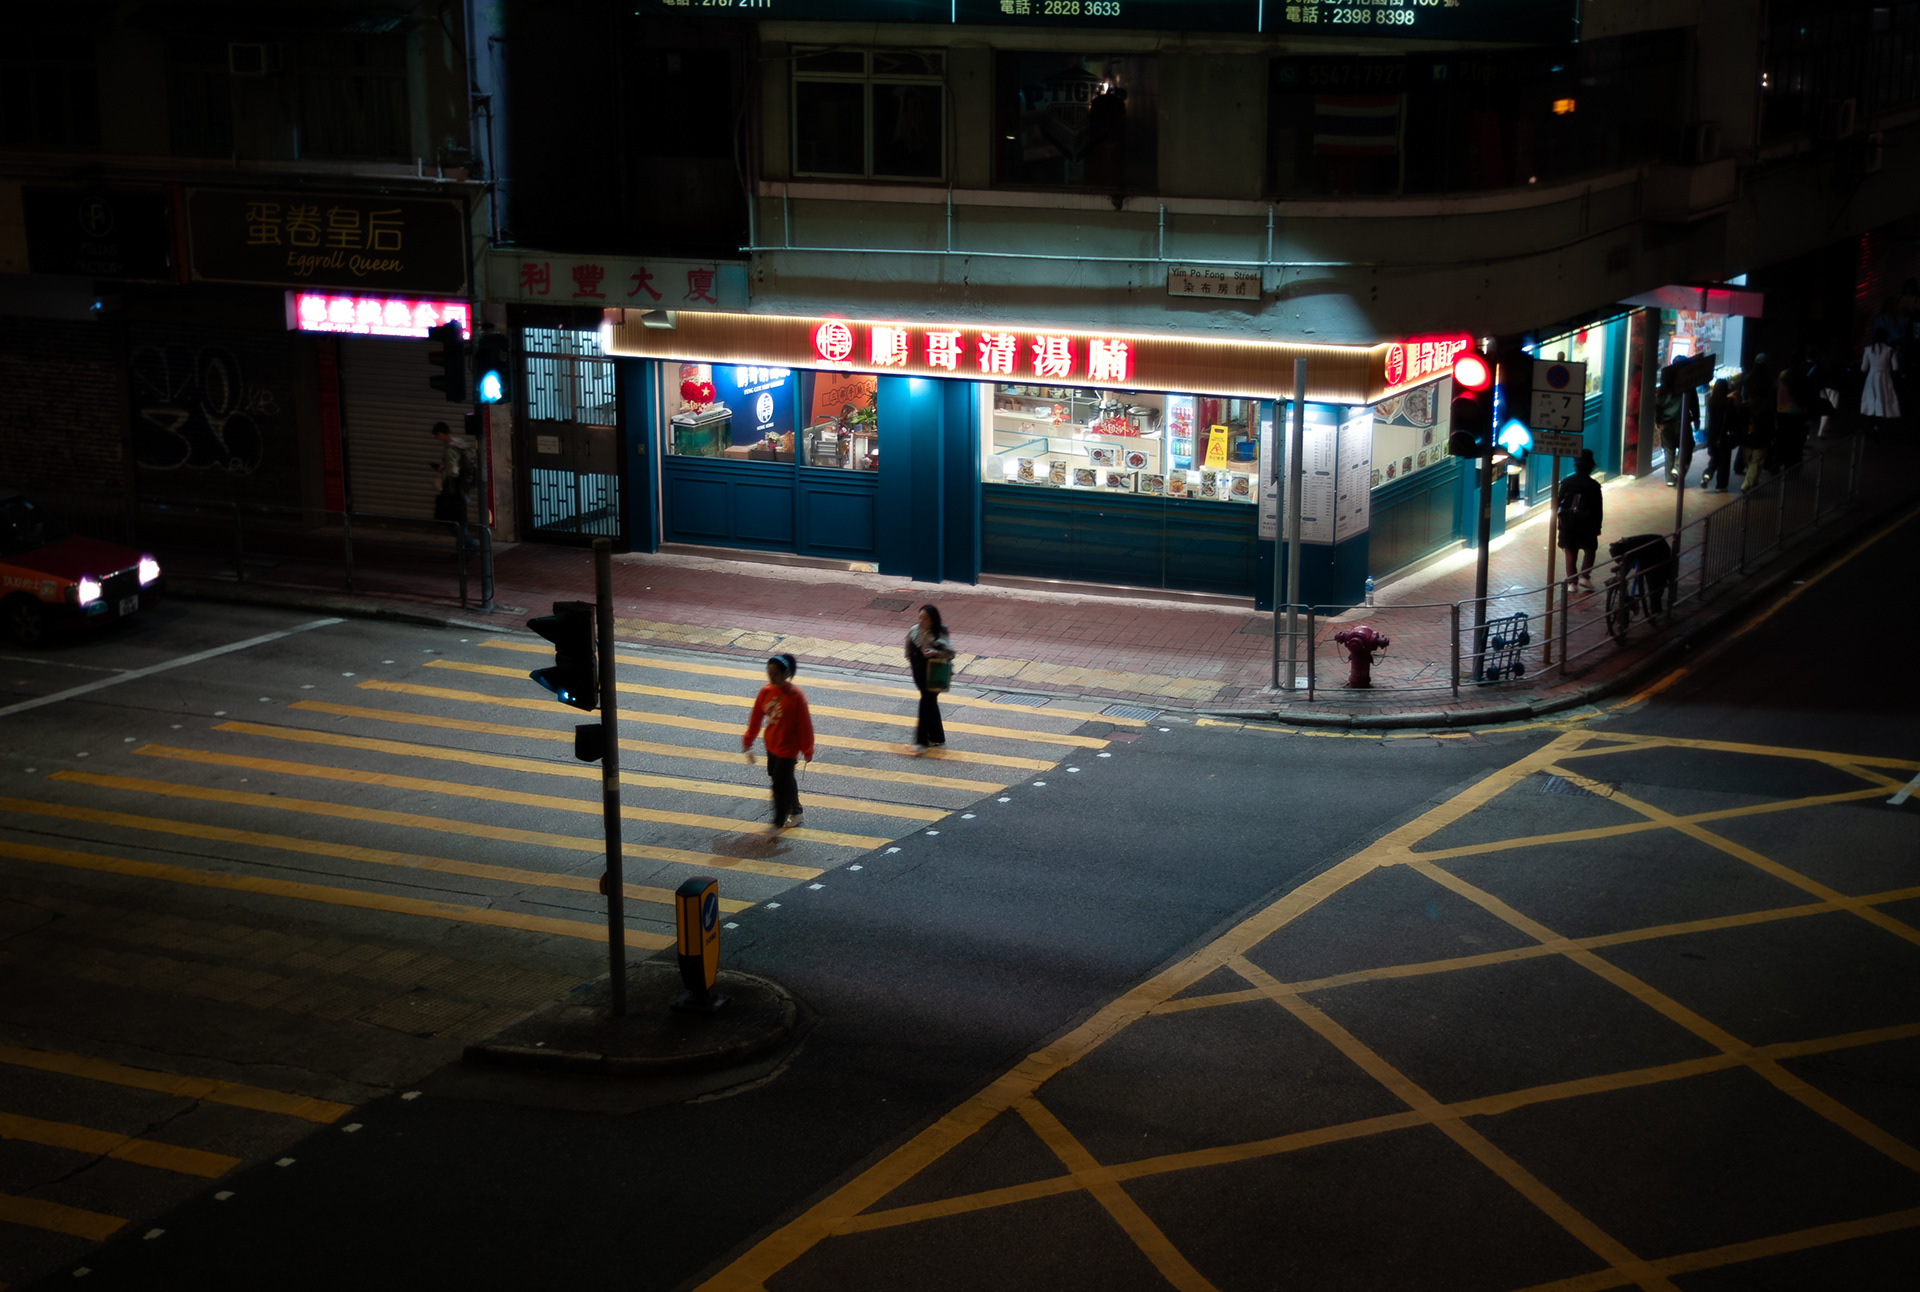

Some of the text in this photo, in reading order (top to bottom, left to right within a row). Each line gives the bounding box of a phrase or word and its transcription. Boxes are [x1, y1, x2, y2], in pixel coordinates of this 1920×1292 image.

[1044, 1, 1080, 15] 2828
[1084, 2, 1120, 16] 3633
[1332, 9, 1371, 25] 2398
[1375, 9, 1415, 26] 8398
[245, 201, 406, 251] 蛋卷皇后
[286, 250, 405, 277] Eggroll Queen
[1172, 268, 1258, 281] Yim Po Fong Street
[519, 261, 717, 305] 利豐大廈
[1183, 282, 1246, 296] 染布房街
[870, 325, 1128, 382] 鵬哥清湯腩
[1562, 397, 1571, 408] 7
[1561, 416, 1569, 428] 7
[3, 575, 22, 588] TAXI
